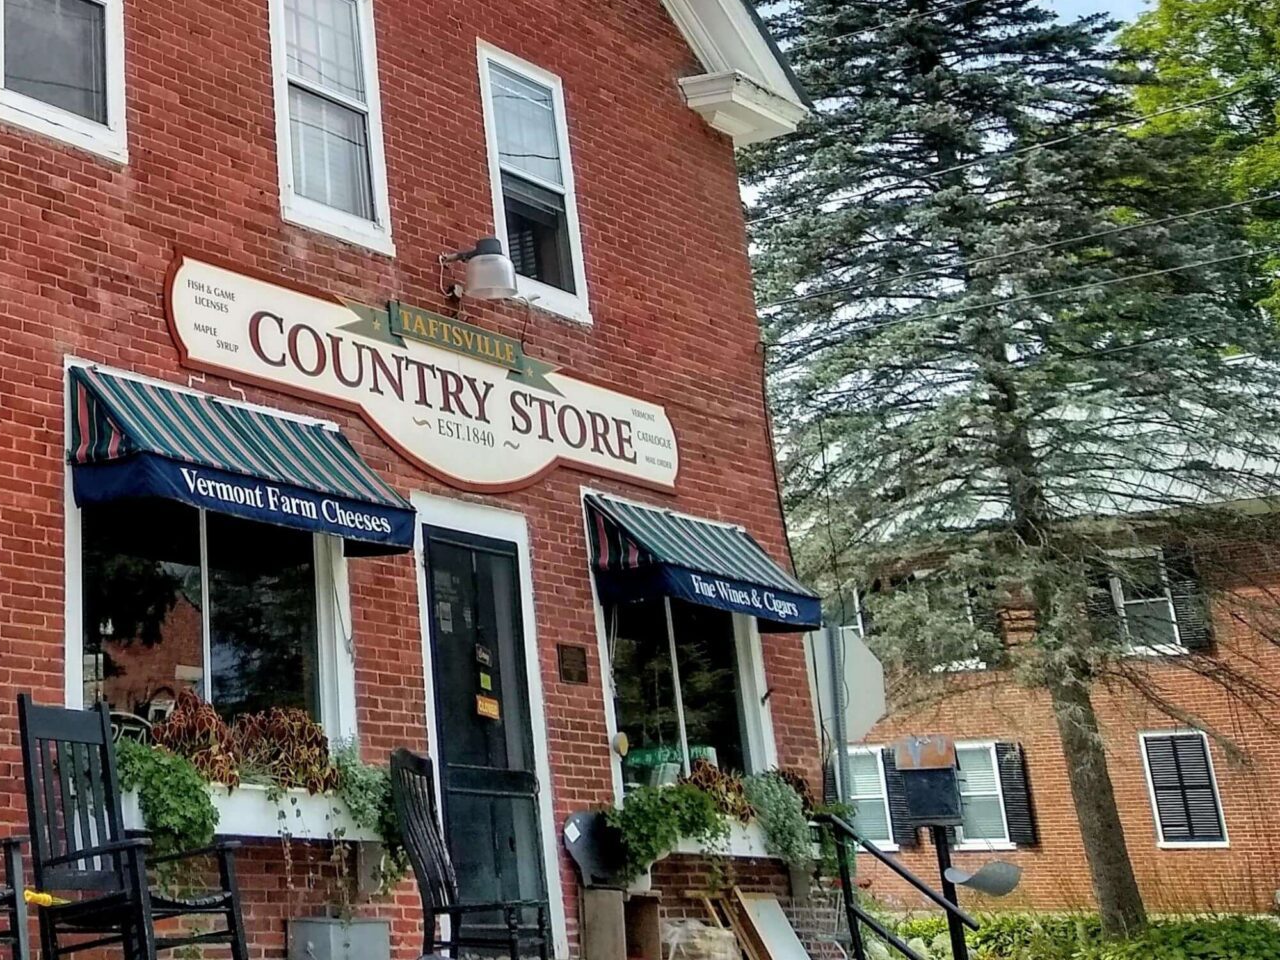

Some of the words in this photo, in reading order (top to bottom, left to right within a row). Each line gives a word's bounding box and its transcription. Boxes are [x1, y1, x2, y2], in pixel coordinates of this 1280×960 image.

[187, 279, 205, 293] FISH
[213, 287, 236, 302] GAME
[194, 295, 229, 313] LICENSES
[193, 322, 218, 337] MAPLE
[400, 310, 516, 364] TAFTSVILLE
[216, 339, 239, 353] SYRUP
[248, 310, 494, 424] COUNTRY
[509, 390, 637, 465] STORE
[631, 408, 656, 422] VERMONT
[437, 418, 495, 448] EST.1840
[636, 430, 673, 450] CATALOGUE
[179, 467, 264, 508] Vermont
[265, 485, 319, 520] Farm
[321, 498, 392, 533] Cheeses
[690, 574, 716, 598] Fine
[715, 580, 751, 606] Wines
[750, 588, 763, 609] &
[763, 591, 799, 618] Cigars
